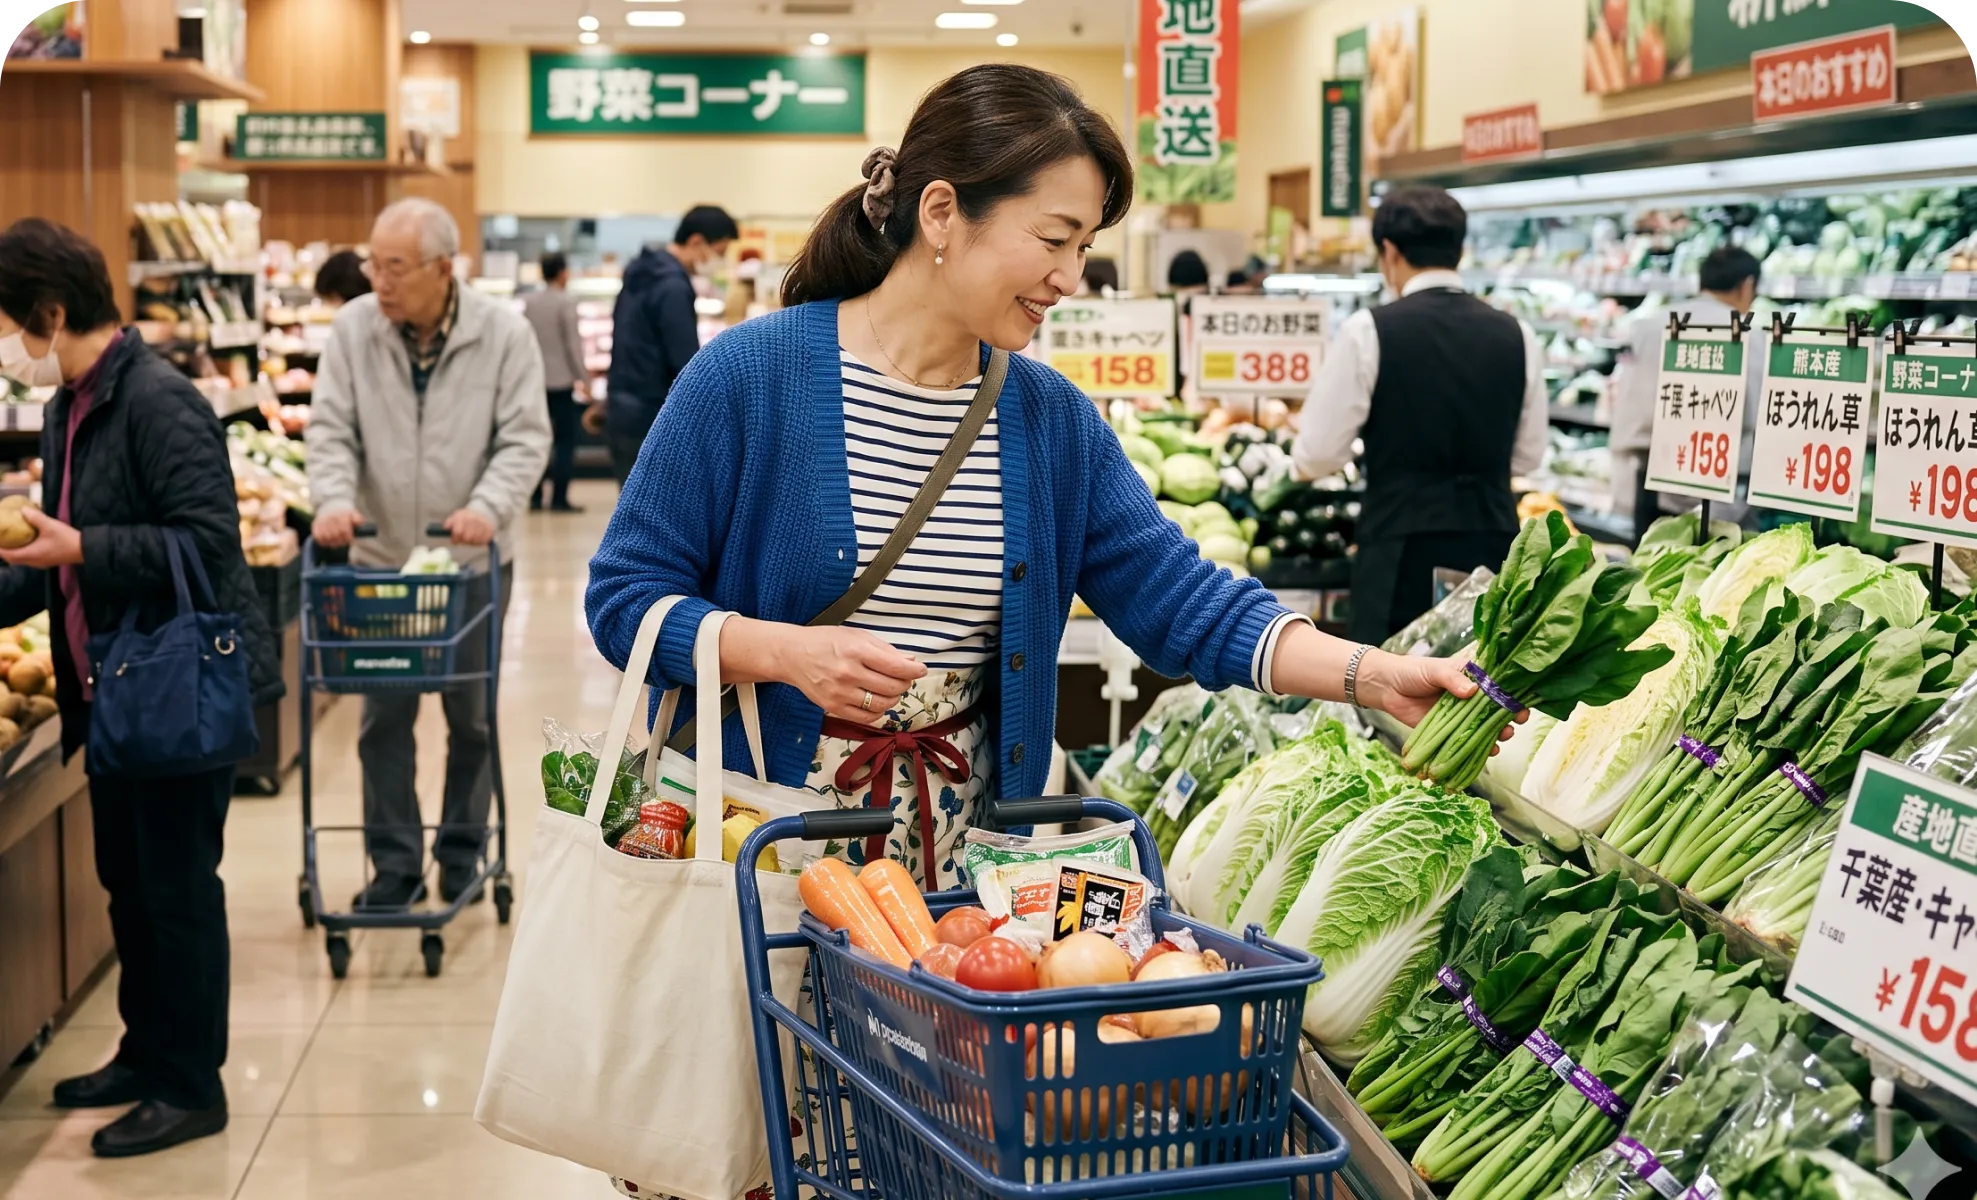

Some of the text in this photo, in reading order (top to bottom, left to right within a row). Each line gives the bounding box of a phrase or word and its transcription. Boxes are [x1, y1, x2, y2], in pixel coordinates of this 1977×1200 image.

[547, 67, 848, 122] 野菜コーナー
[1758, 44, 1889, 109] 本日のおすすめ
[1201, 312, 1321, 336] 本日のお野菜
[1089, 355, 1156, 385] 158
[1241, 352, 1310, 382] 388
[1792, 347, 1842, 378] 熊本産
[1766, 389, 1863, 435] ほうれん草
[1677, 430, 1730, 478] ¥158
[1785, 442, 1852, 495] ¥198
[1840, 848, 1977, 951] 千葉産・キャ
